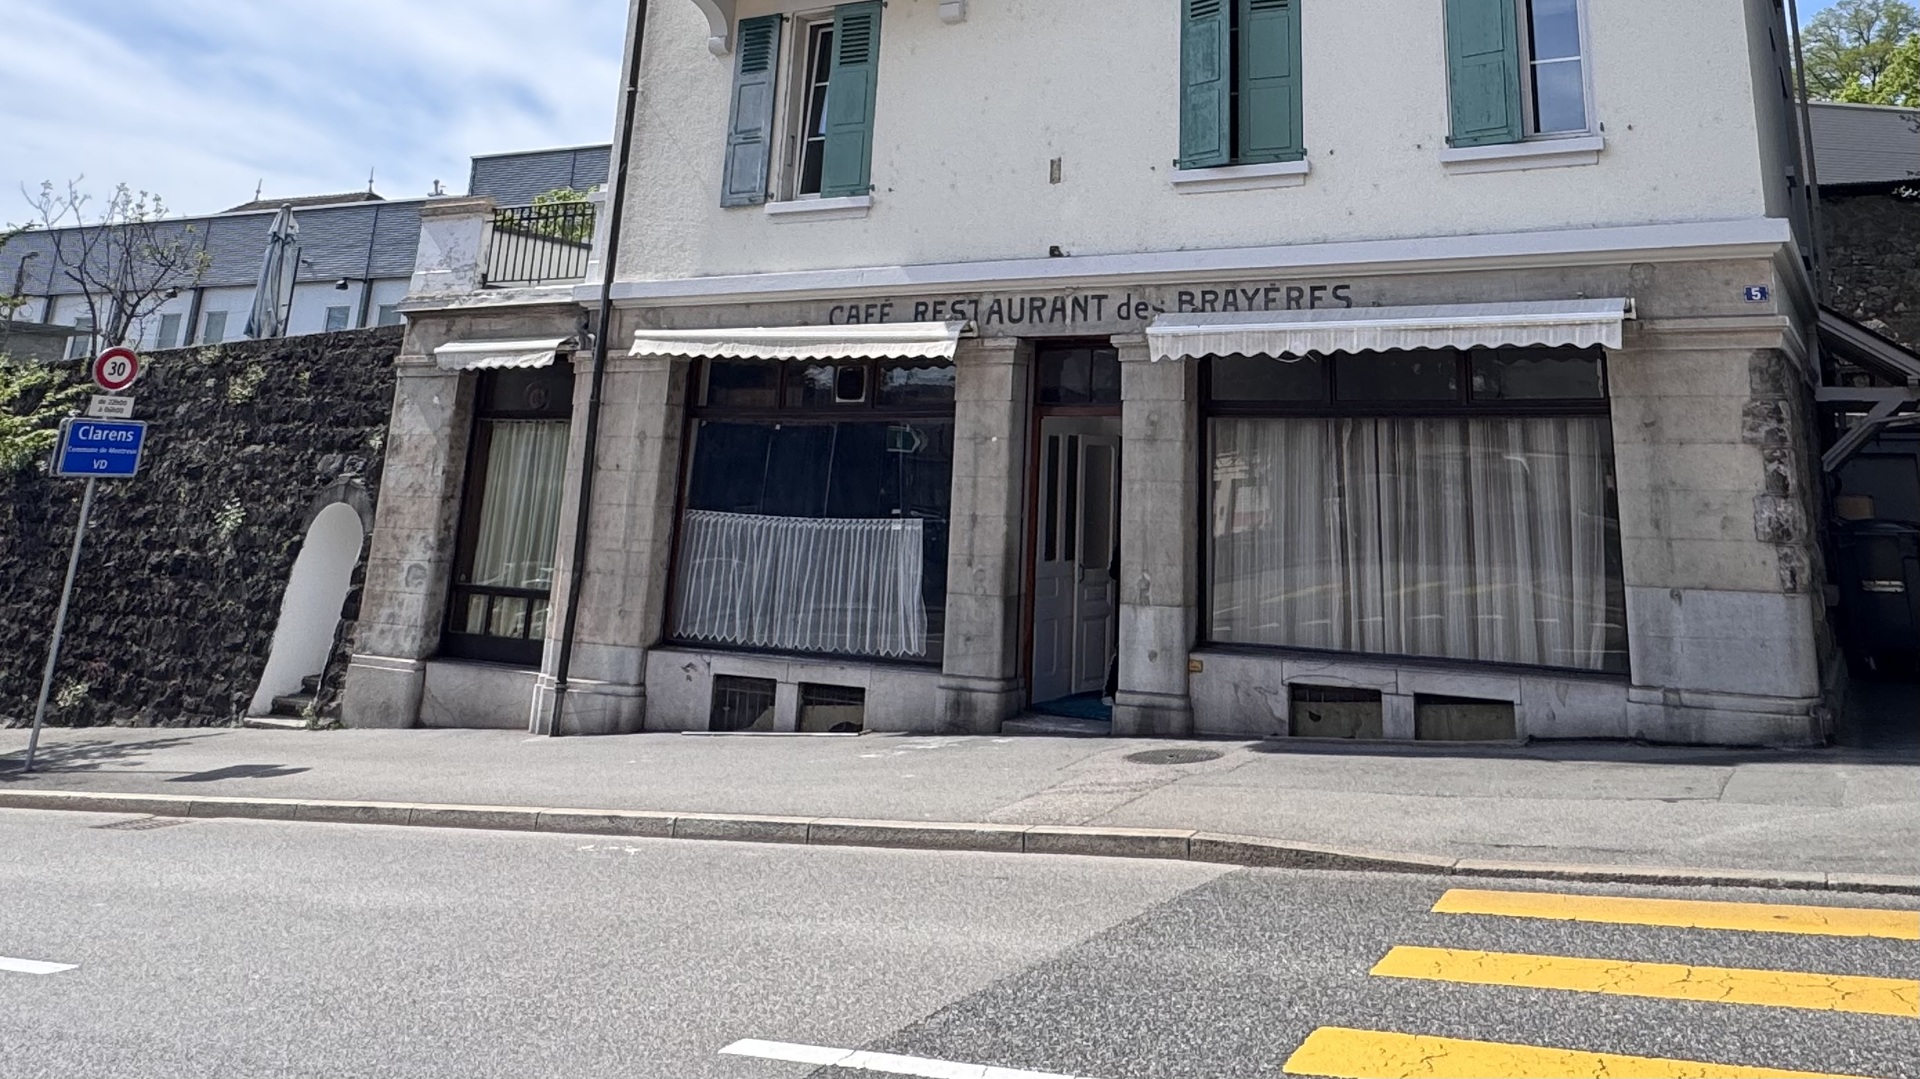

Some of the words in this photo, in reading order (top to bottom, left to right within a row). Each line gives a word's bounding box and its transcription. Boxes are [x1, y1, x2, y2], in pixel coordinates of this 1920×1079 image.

[1751, 287, 1761, 300] 5
[914, 294, 1109, 325] RESTAURANT
[107, 361, 126, 377] 30
[78, 425, 134, 442] Clarens
[93, 459, 108, 469] VD
